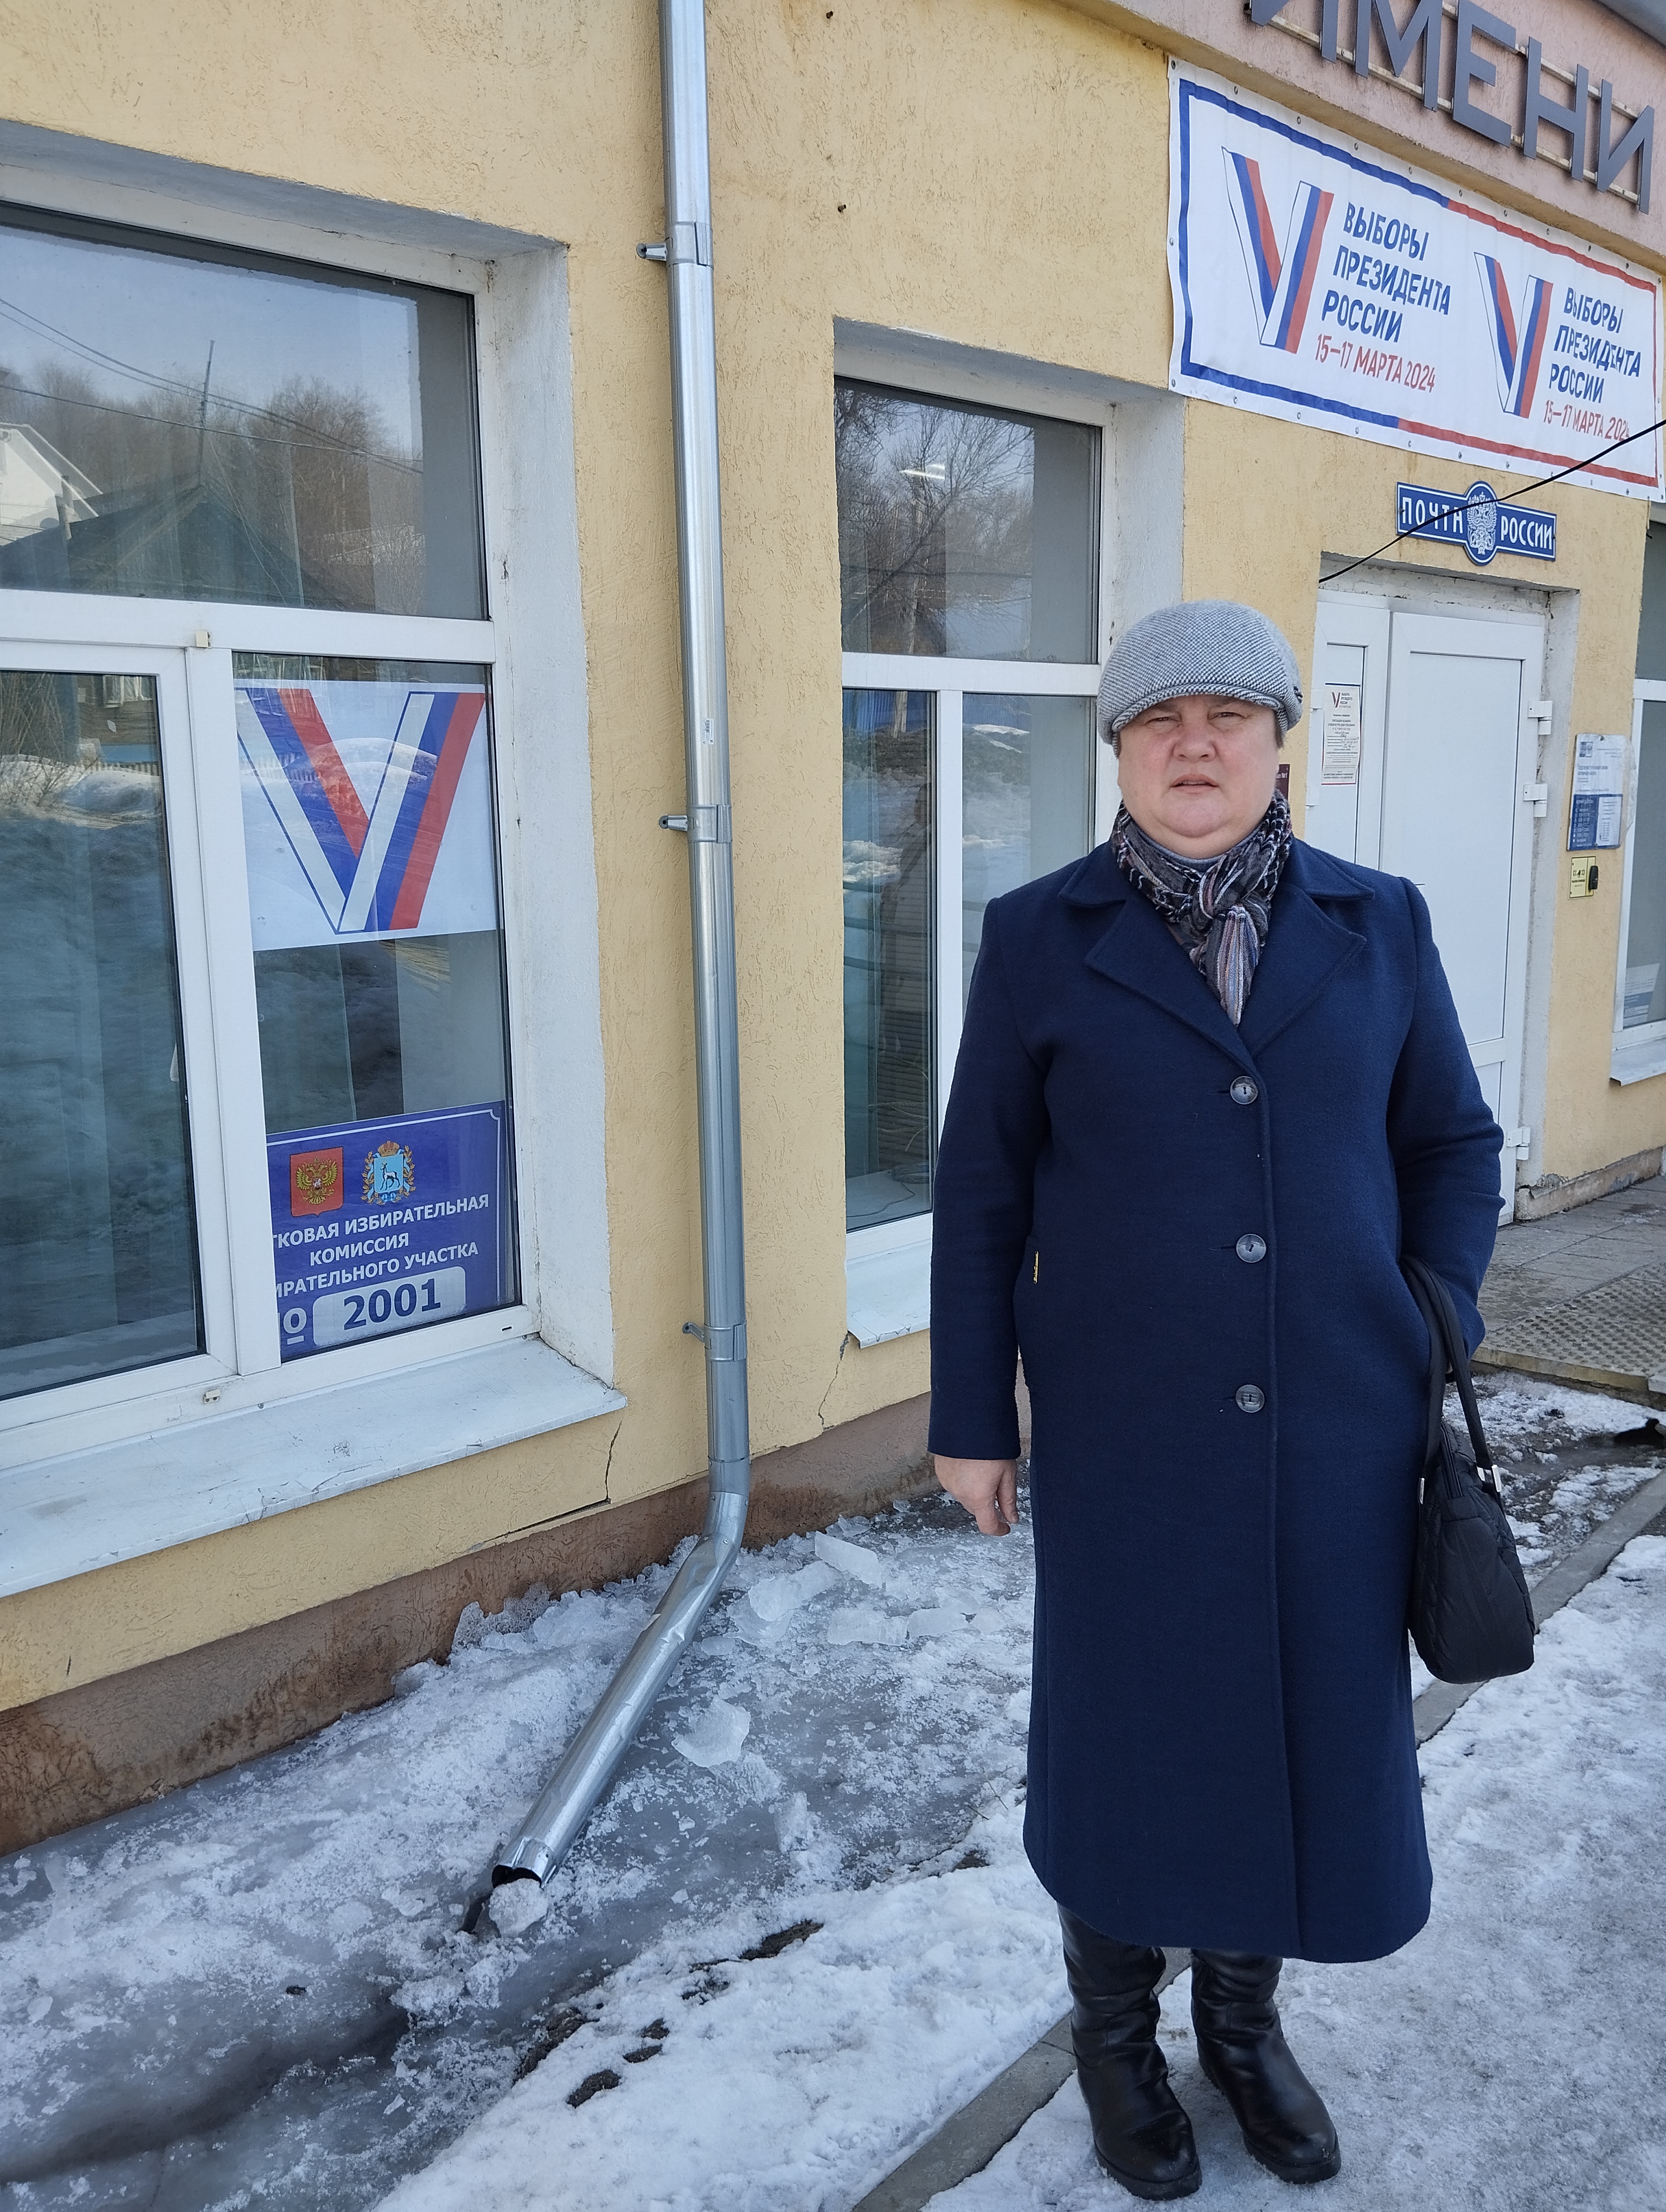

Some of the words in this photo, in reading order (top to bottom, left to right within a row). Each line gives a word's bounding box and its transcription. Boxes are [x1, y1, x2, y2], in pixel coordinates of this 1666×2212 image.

[1343, 201, 1430, 261] ВЫБОРЫ
[1332, 245, 1451, 316] ПРЕЗИДЕНТА
[1321, 290, 1404, 343] РОССИИ
[1564, 287, 1624, 333] ВЫБОРЫ
[1353, 346, 1402, 383] МАРТА
[1404, 361, 1436, 393] 2024
[1553, 324, 1641, 377] ПРЕЗИДЕНТА
[1549, 363, 1605, 403] РОССИИ
[1572, 408, 1604, 438] МАРТА
[1402, 497, 1463, 533] ПОЧТА
[1501, 516, 1552, 550] РОССИИ
[345, 1194, 489, 1235] ИЗБИРАТЕЛЬНАЯ
[310, 1232, 409, 1266] КОМИССИЯ
[404, 1242, 479, 1270] УЧАСТКА
[344, 1277, 441, 1330] 2001
